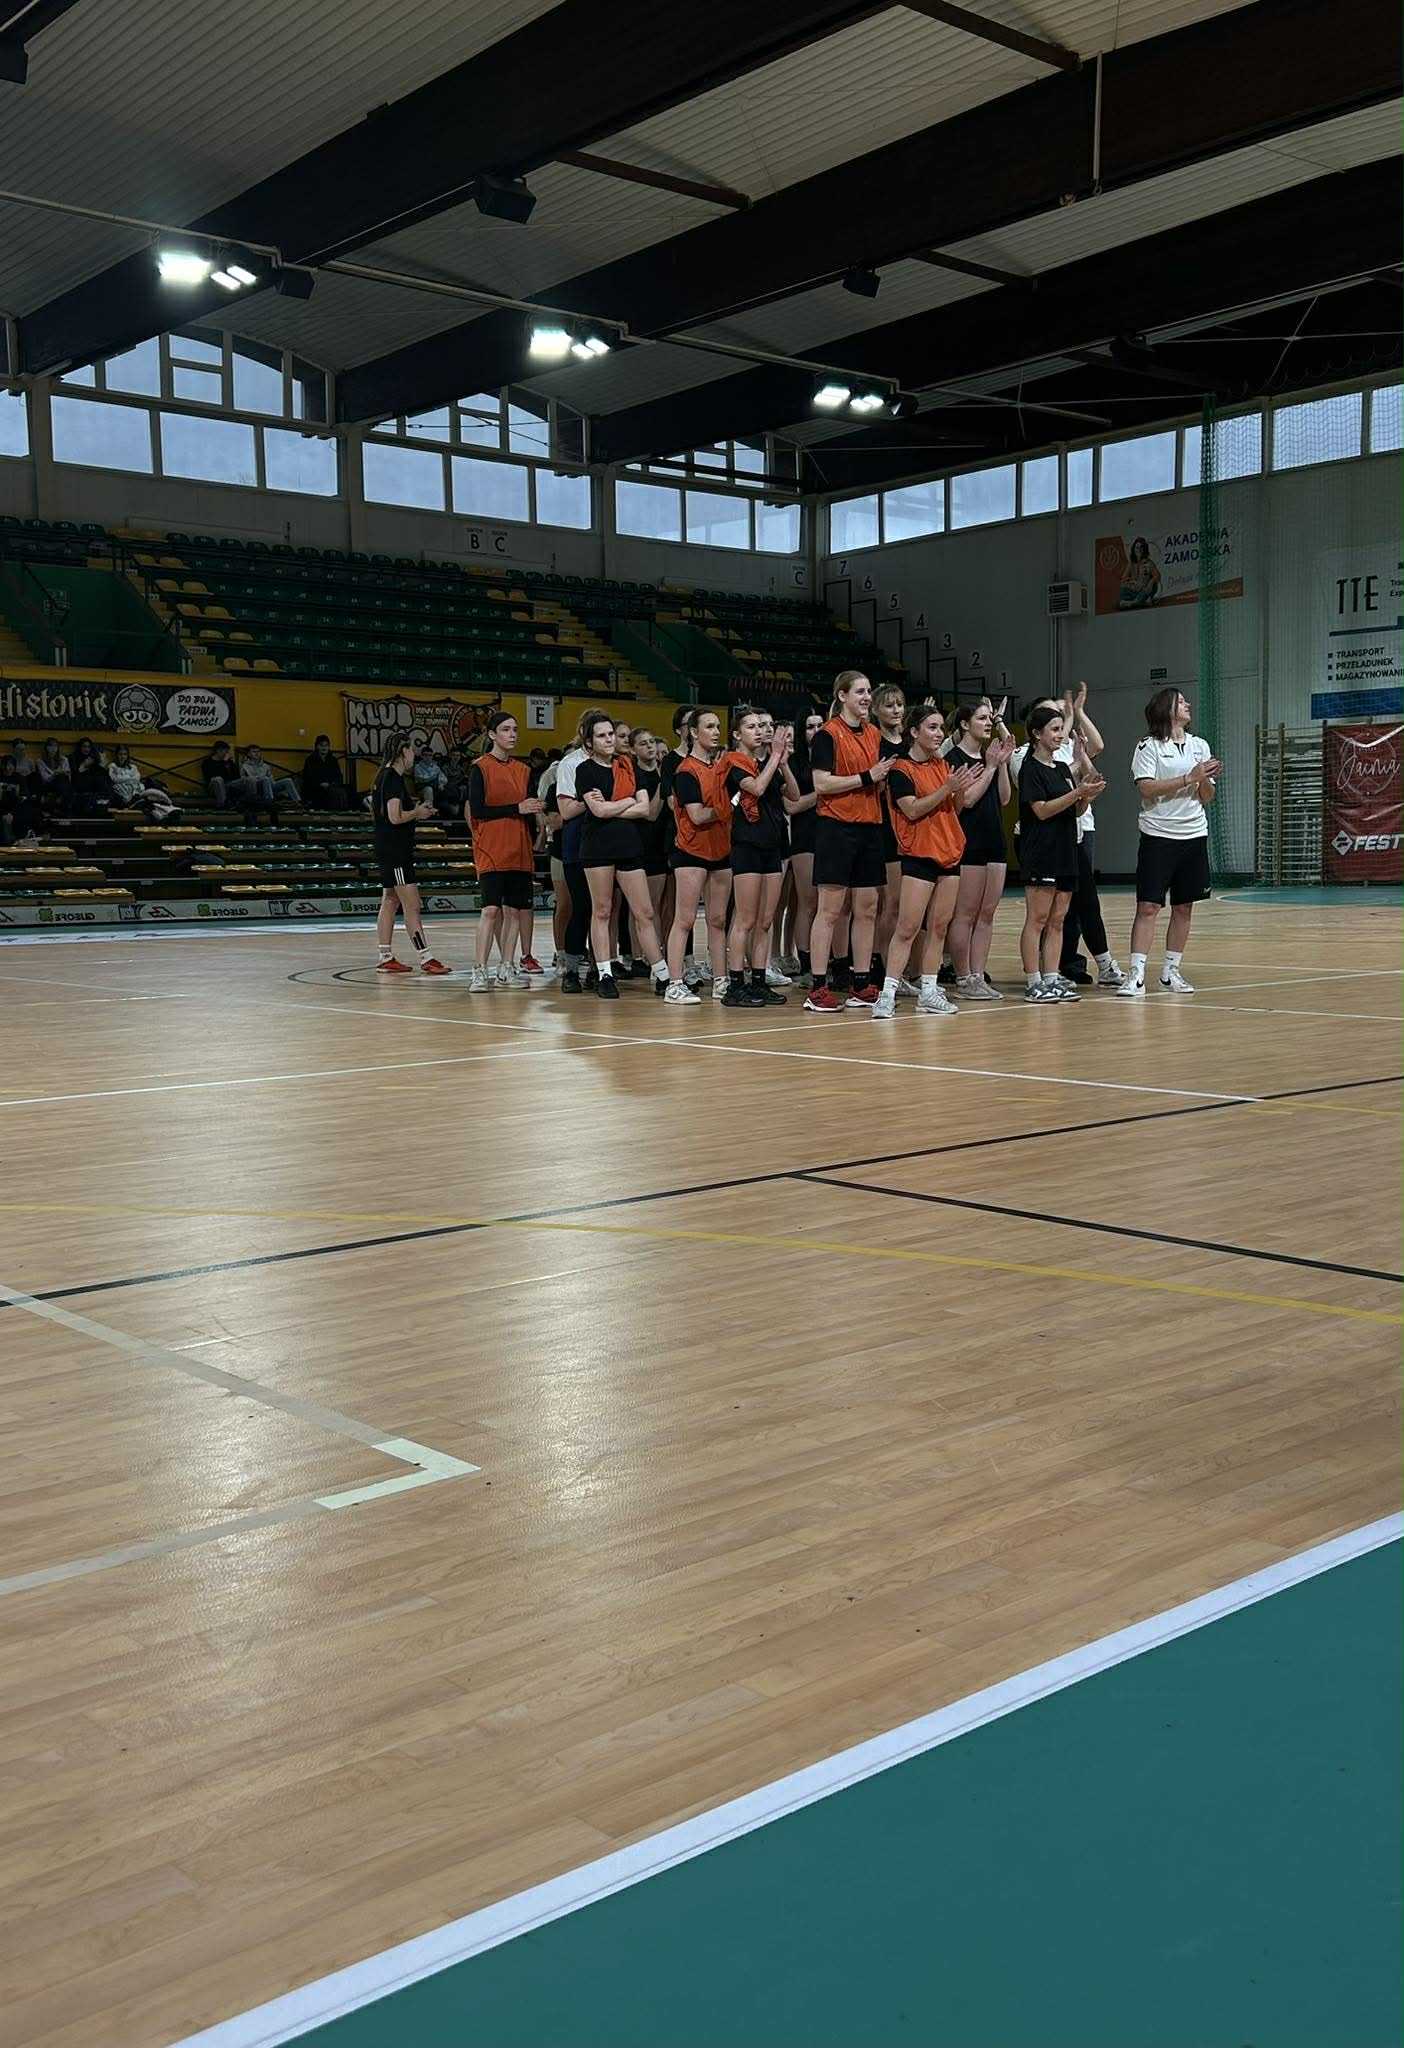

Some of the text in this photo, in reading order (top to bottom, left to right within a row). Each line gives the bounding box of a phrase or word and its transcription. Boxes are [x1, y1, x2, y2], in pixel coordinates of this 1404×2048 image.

[470, 534, 480, 549] B
[495, 537, 505, 552] C
[1164, 544, 1231, 564] ZAMOSKA
[840, 560, 848, 575] 7
[794, 571, 804, 585] C
[864, 575, 872, 590] 6
[890, 593, 898, 609] 5
[1336, 575, 1378, 614] TTE
[916, 613, 925, 628] 4
[943, 633, 952, 648] 3
[971, 652, 980, 666] 2
[1336, 647, 1385, 659] TRANSPORT
[1336, 657, 1394, 670] PRZEŁADUNEK
[1001, 672, 1007, 687] 1
[177, 695, 216, 705] DO BOJU
[177, 705, 217, 717] PADWA
[348, 700, 414, 728] KLUB
[536, 707, 545, 724] E
[176, 716, 219, 727] ZAMOŚĆ!
